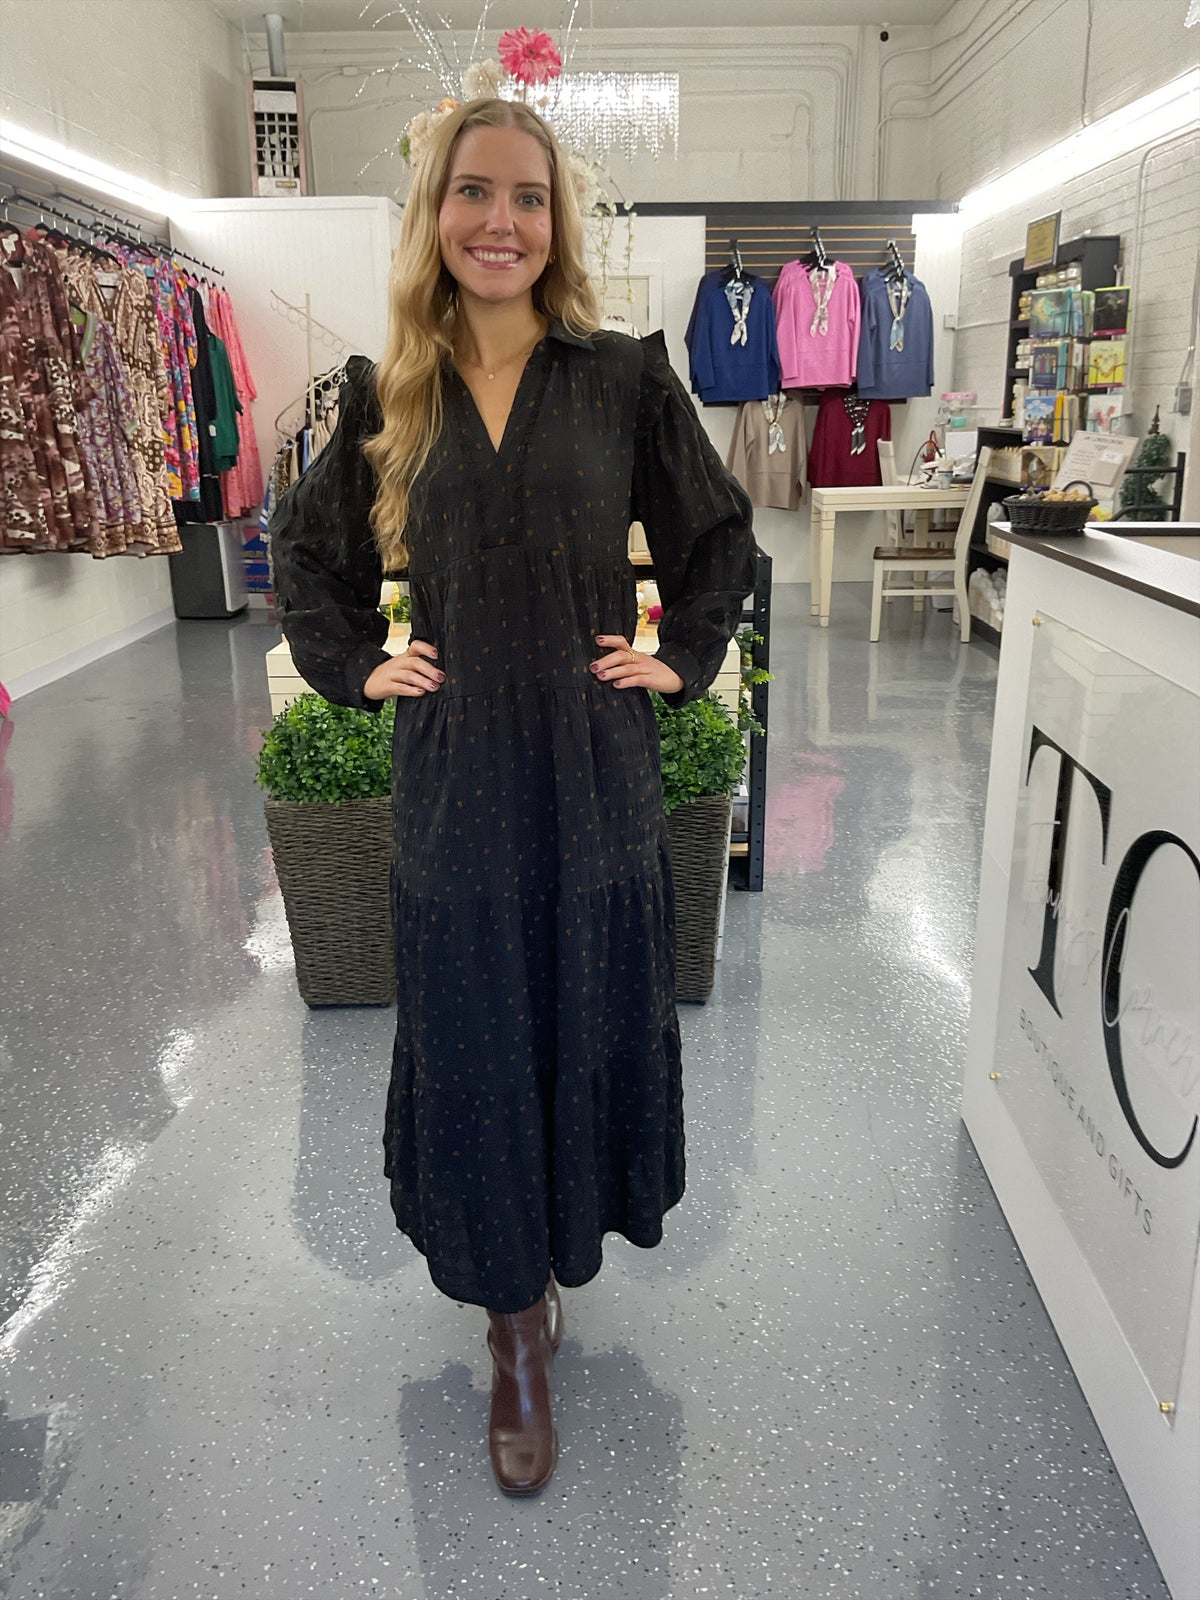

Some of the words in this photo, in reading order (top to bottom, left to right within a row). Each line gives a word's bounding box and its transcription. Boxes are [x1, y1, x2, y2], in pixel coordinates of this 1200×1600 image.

[1019, 1008, 1076, 1111] BOUTIQUE
[1077, 1105, 1105, 1157] AND
[1108, 1153, 1153, 1236] GIFTS
